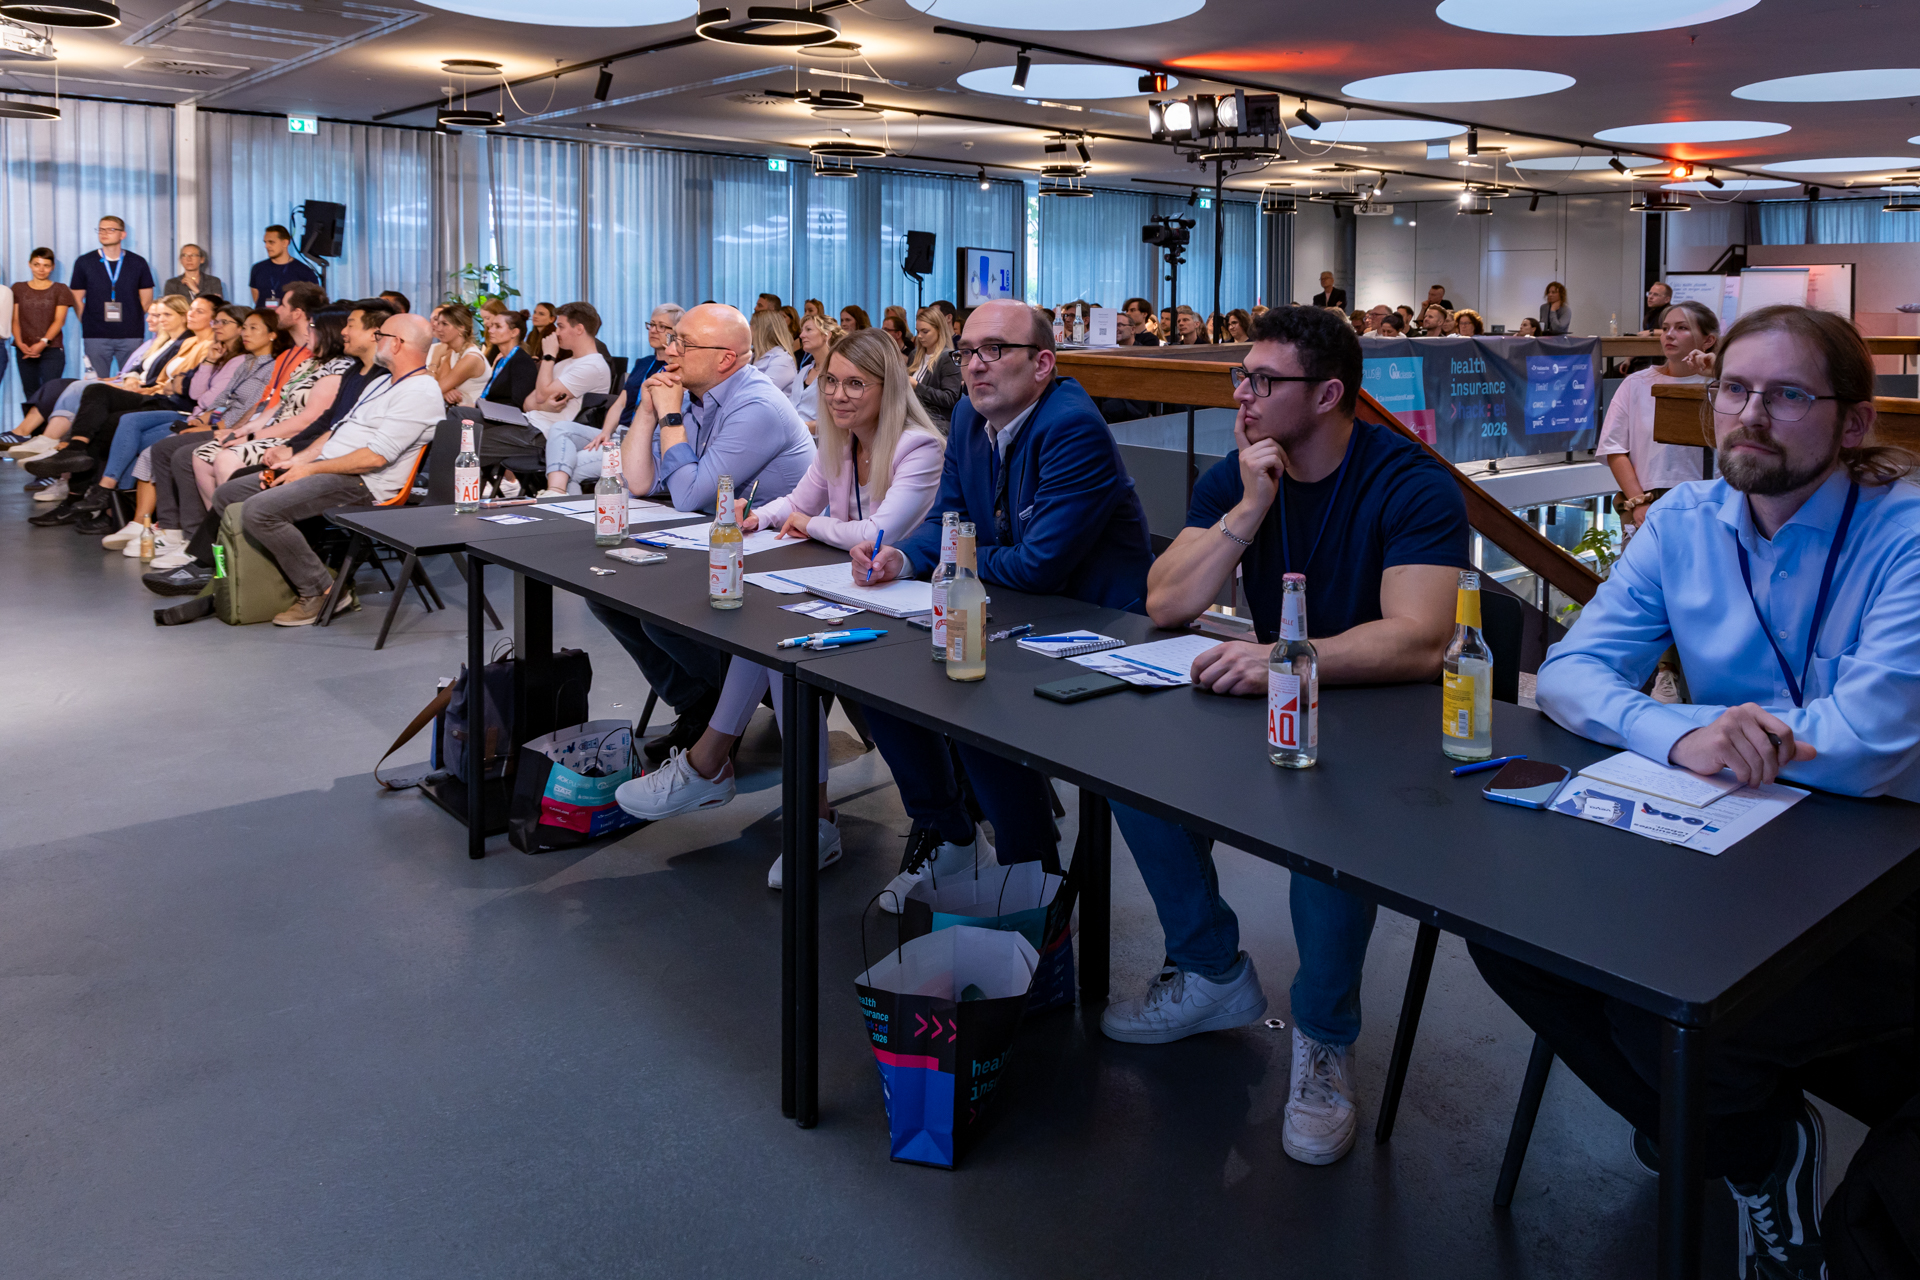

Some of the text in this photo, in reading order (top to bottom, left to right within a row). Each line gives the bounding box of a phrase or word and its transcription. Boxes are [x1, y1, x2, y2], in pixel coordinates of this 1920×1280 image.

[1451, 357, 1486, 374] health
[1451, 378, 1506, 396] insurance
[1481, 422, 1508, 437] 2026
[872, 1032, 888, 1044] 2026
